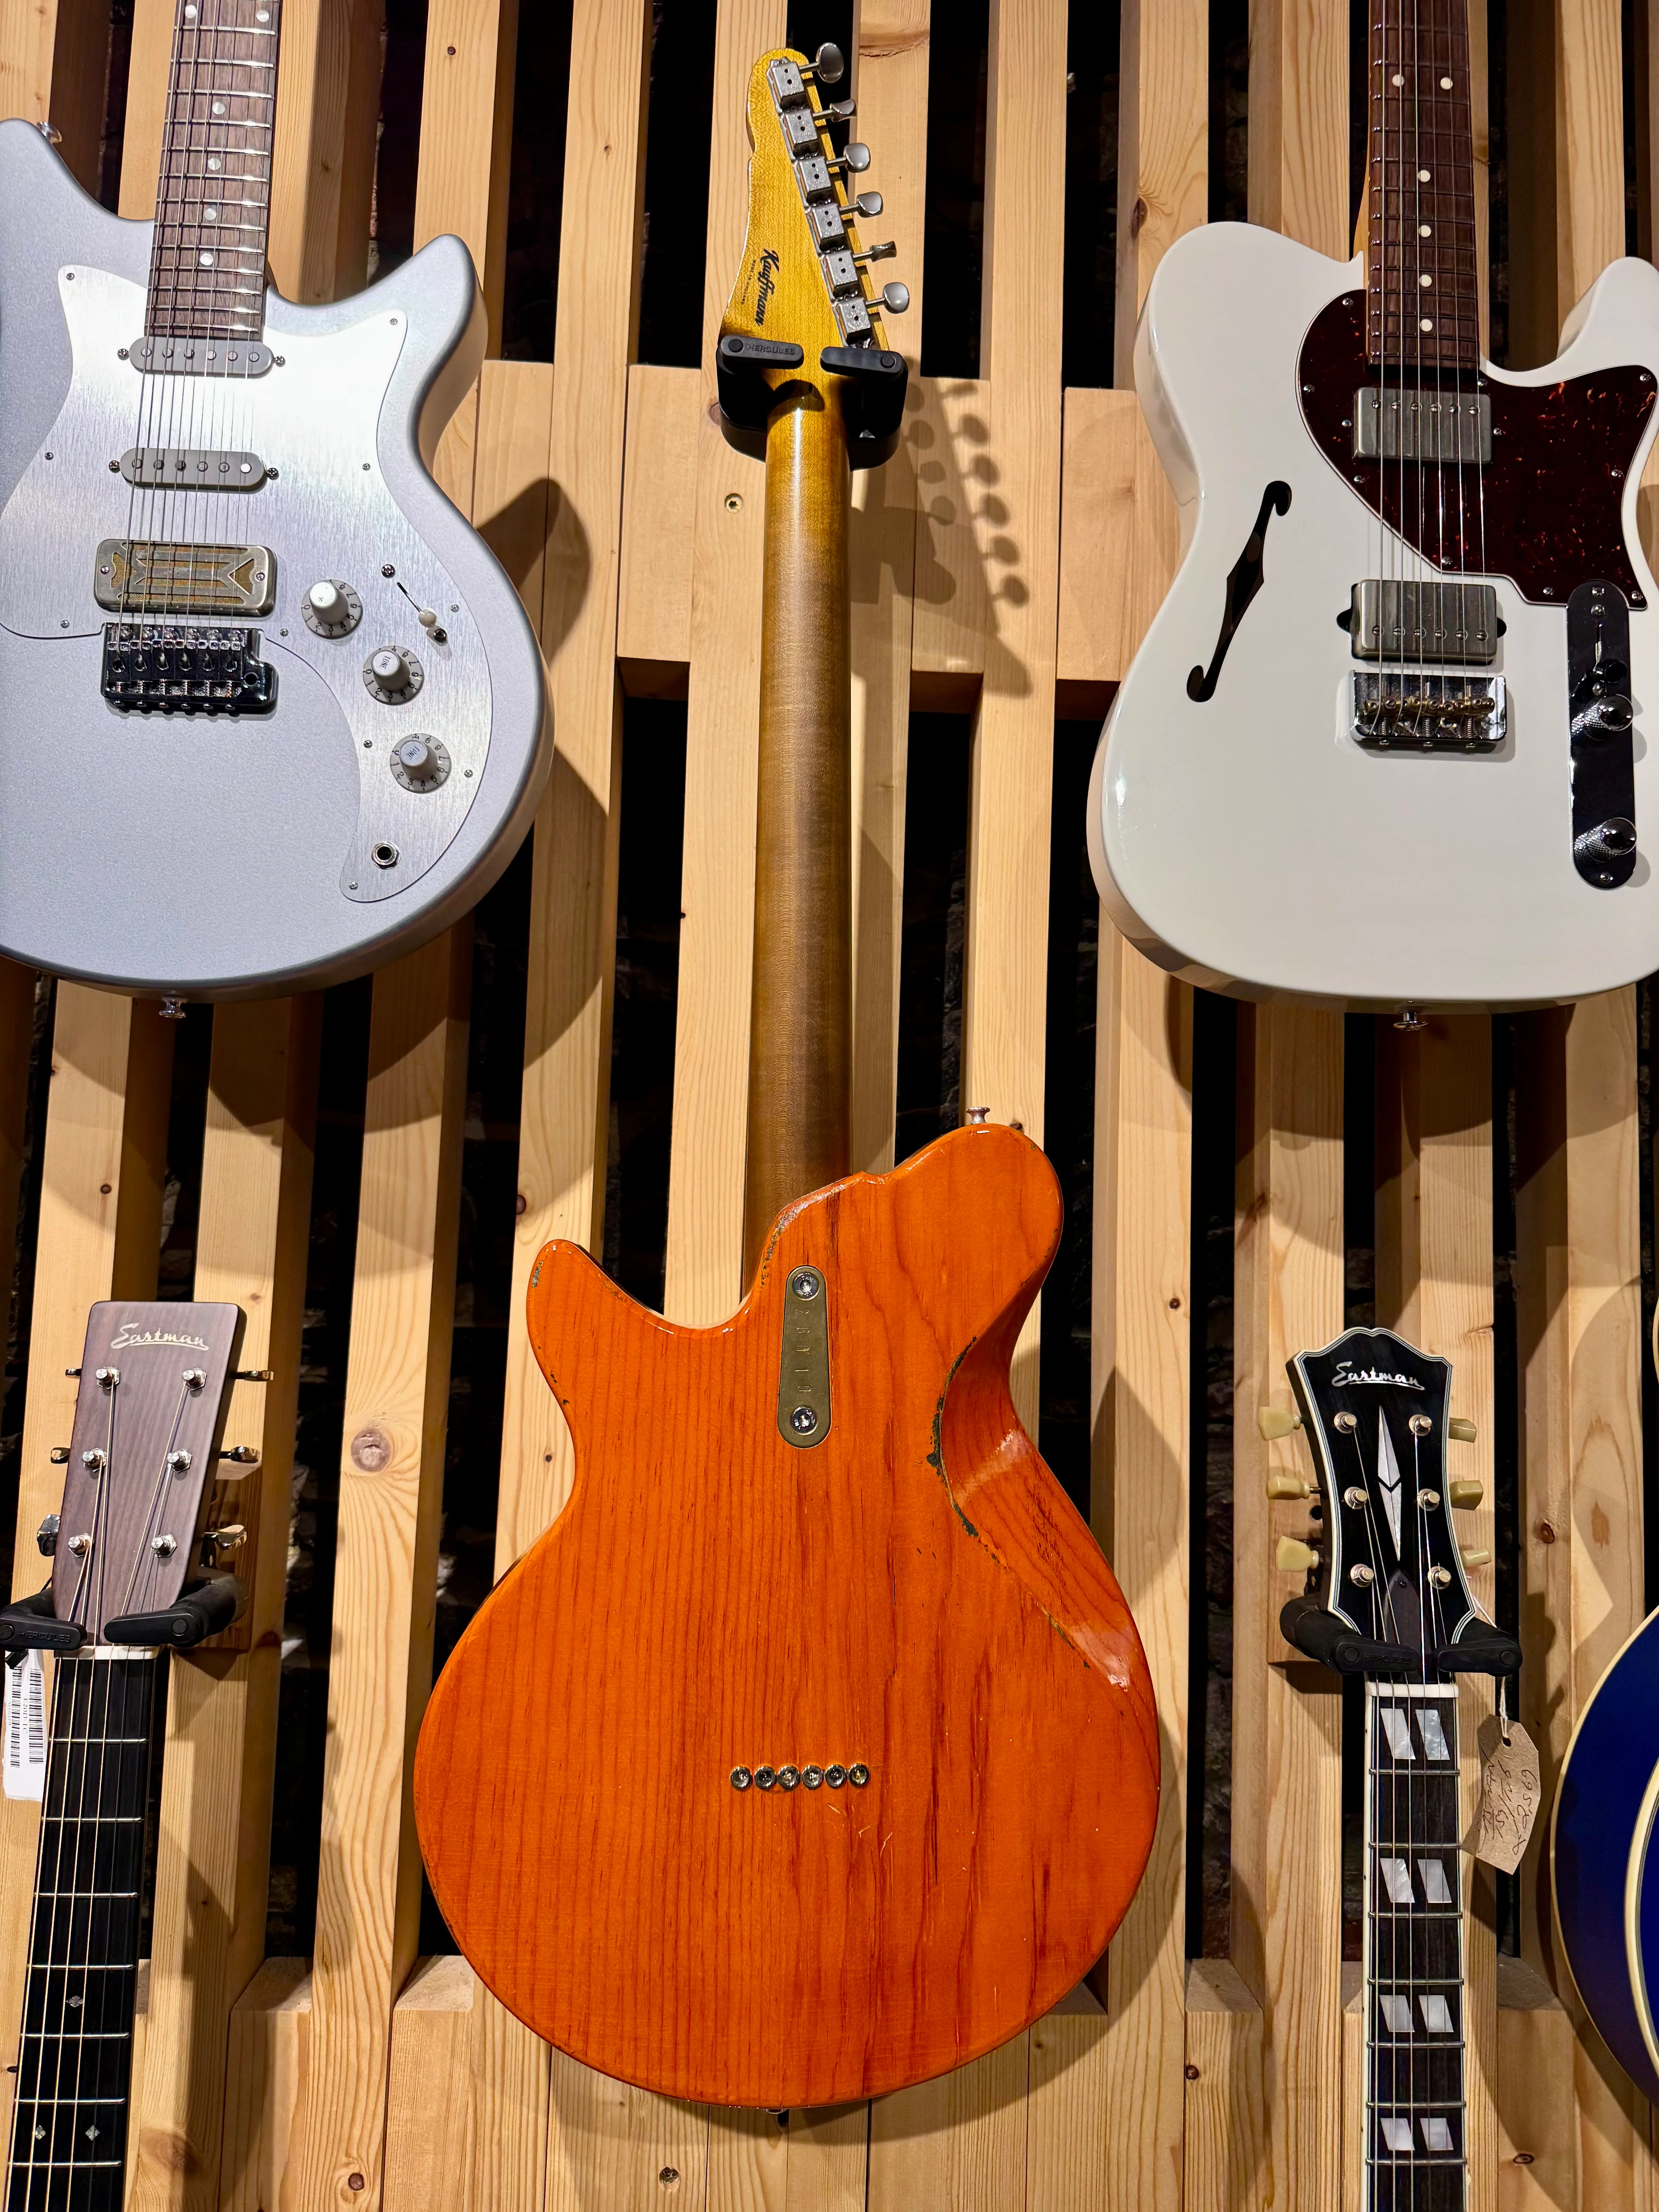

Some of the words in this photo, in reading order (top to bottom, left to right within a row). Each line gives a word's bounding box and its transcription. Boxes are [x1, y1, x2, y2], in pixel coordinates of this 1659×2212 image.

[755, 248, 780, 326] Kauffmann
[748, 343, 795, 355] HERCULES
[316, 622, 322, 630] 2
[340, 621, 346, 629] 4
[380, 655, 392, 670] TONE
[375, 687, 382, 696] 2
[388, 690, 393, 699] 3
[406, 746, 420, 760] TONE
[111, 1322, 209, 1351] Eastman
[1331, 1361, 1425, 1391] Eastman
[19, 1630, 71, 1643] HERCULES
